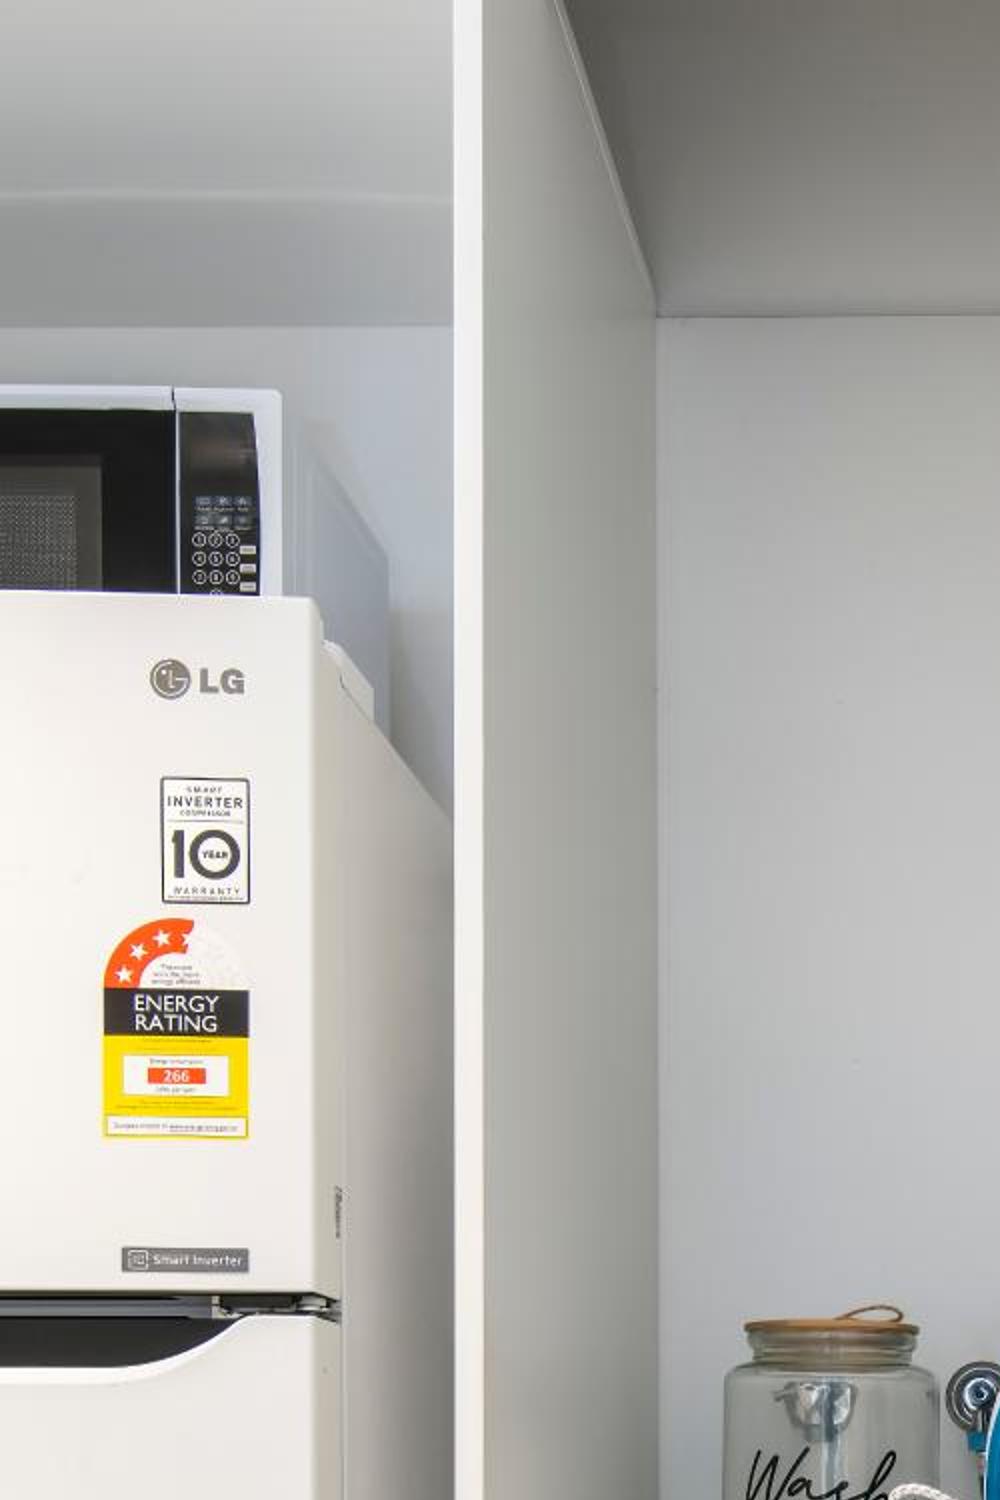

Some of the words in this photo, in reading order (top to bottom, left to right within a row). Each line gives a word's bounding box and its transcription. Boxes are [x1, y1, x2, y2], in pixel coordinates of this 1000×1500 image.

[199, 668, 245, 694] LG
[167, 795, 244, 809] INVERTER
[171, 829, 241, 880] 10
[201, 849, 229, 860] YEAR
[173, 886, 241, 895] WARRANTY
[133, 994, 220, 1013] ENERGY
[134, 1015, 218, 1033] RATING
[153, 1254, 189, 1265] Smart
[193, 1254, 242, 1266] Inverter
